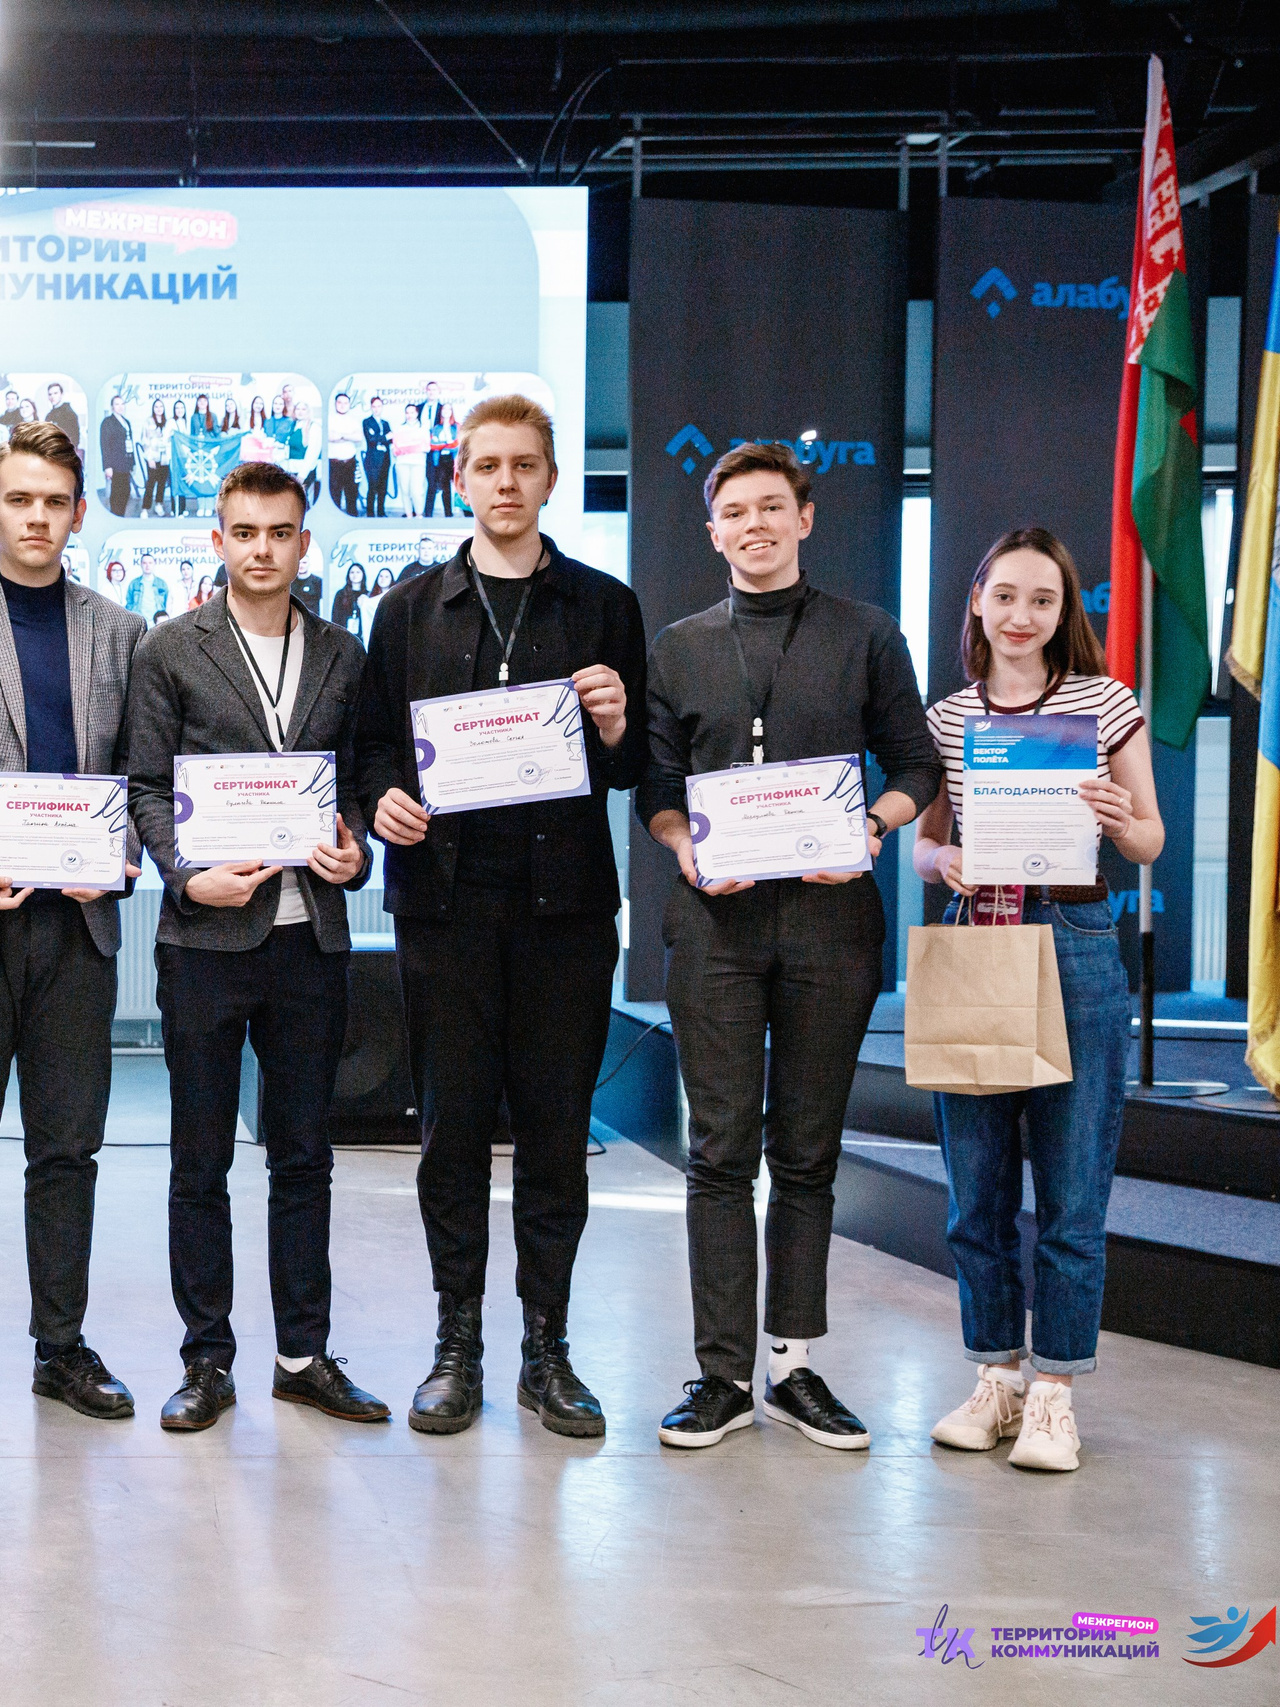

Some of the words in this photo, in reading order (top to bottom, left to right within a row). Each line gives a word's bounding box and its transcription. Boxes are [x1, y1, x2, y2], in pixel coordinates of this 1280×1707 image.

[65, 207, 228, 239] МЕЖРЕГИОН
[729, 433, 876, 475] буга
[453, 711, 541, 732] СЕРТИФИКАТ
[973, 755, 1009, 763] ПОЛЁТА
[213, 780, 298, 790] СЕРТИФИКАТ
[973, 787, 1079, 796] БЛАГОДАРНОСТЬ
[730, 786, 821, 805] СЕРТИФИКАТ
[6, 801, 91, 812] СЕРТИФИКАТ
